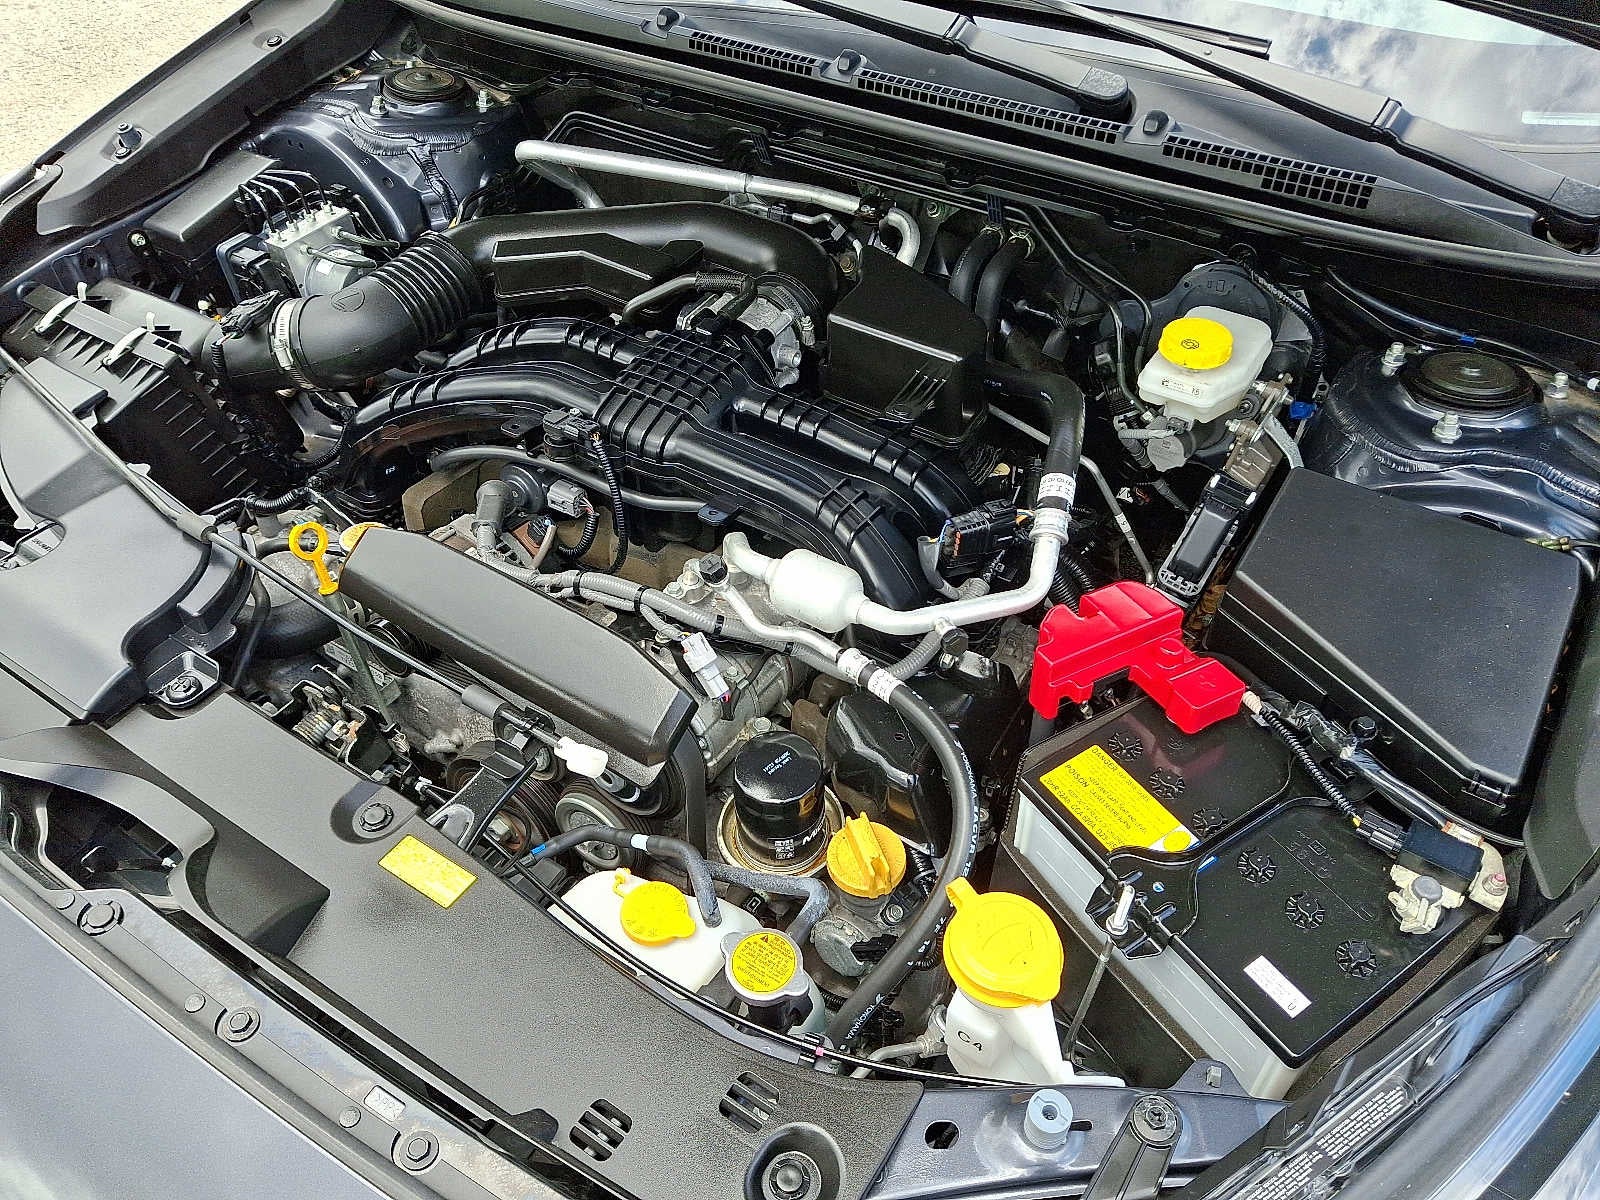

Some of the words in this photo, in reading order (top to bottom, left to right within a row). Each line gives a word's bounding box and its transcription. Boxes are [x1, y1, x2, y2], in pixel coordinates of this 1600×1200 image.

[960, 752, 977, 798] YOKOHAMA
[1092, 748, 1118, 772] DANGER
[1065, 765, 1088, 787] POISON
[847, 1003, 875, 1039] YOKOHAMA
